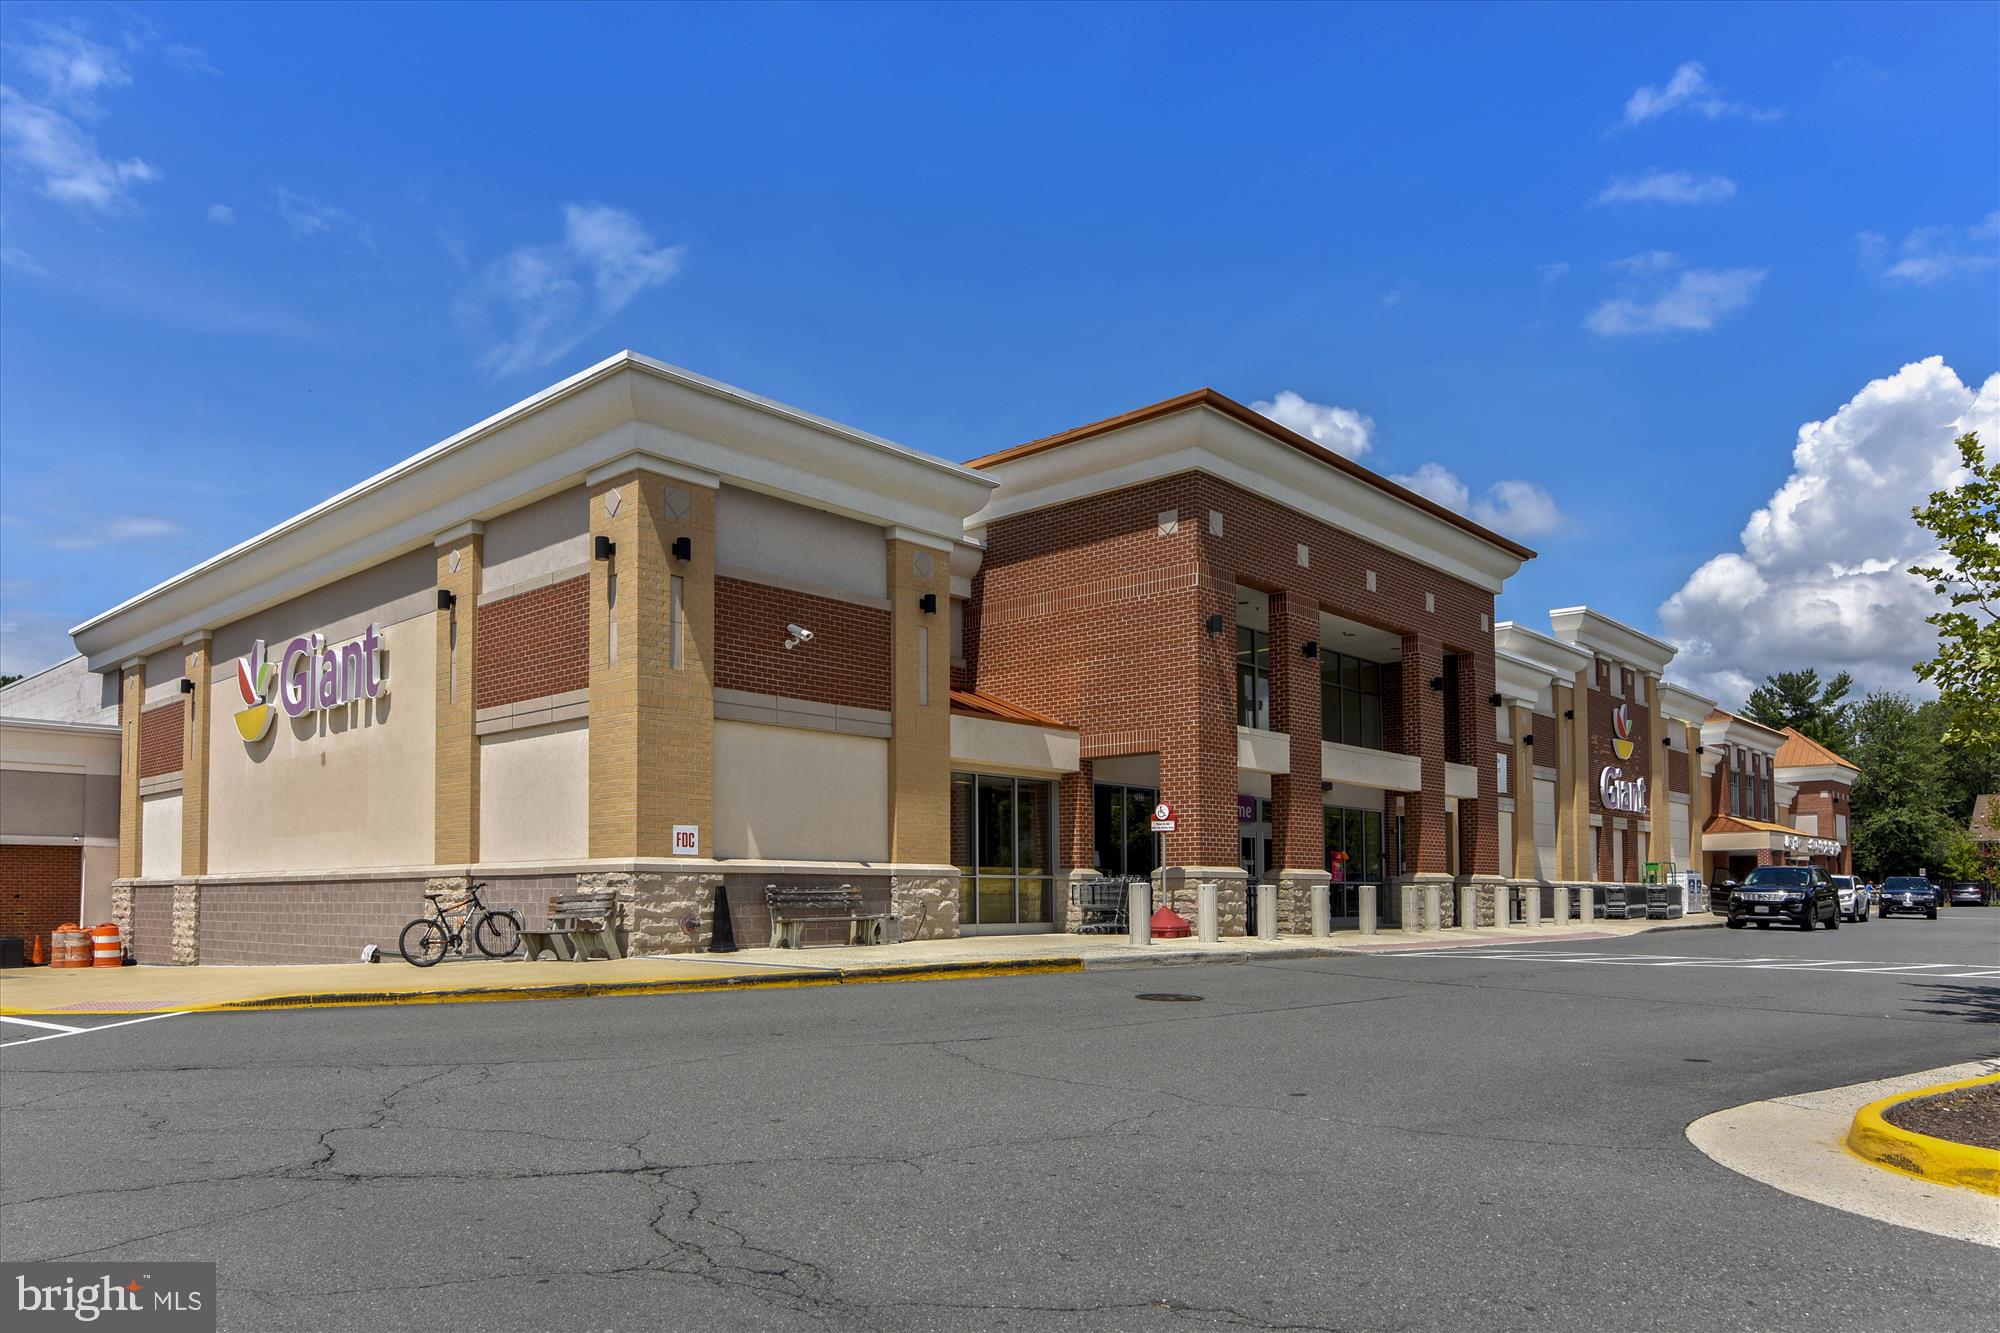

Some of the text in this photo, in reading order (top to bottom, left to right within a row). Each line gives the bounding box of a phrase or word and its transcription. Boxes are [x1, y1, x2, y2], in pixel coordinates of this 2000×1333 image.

[280, 622, 385, 718] Giant
[1600, 766, 1648, 814] Giant
[676, 831, 696, 849] FDC
